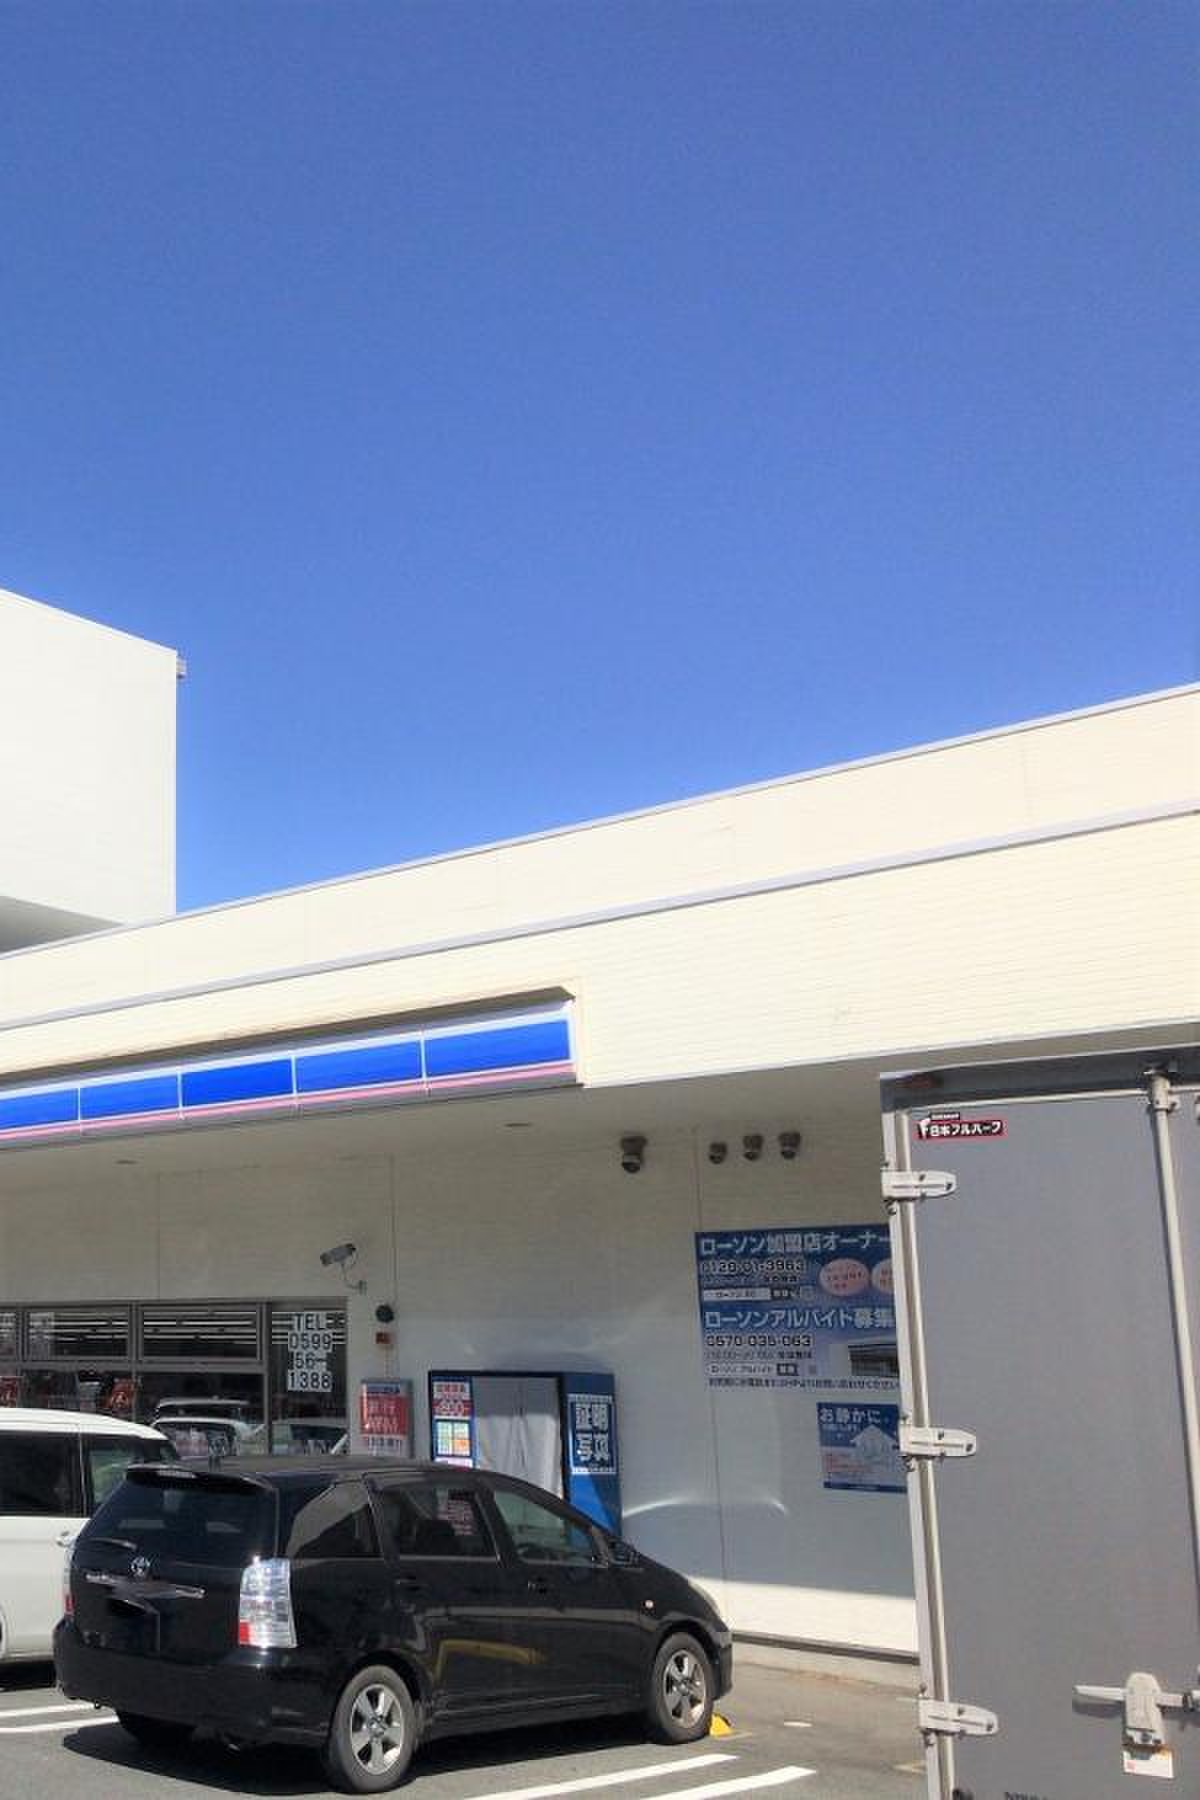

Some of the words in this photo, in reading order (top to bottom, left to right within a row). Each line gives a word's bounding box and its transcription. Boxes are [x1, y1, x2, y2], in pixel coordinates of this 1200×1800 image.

[293, 1313, 326, 1331] TEL
[289, 1332, 332, 1351] 0599
[289, 1371, 331, 1390] 1388
